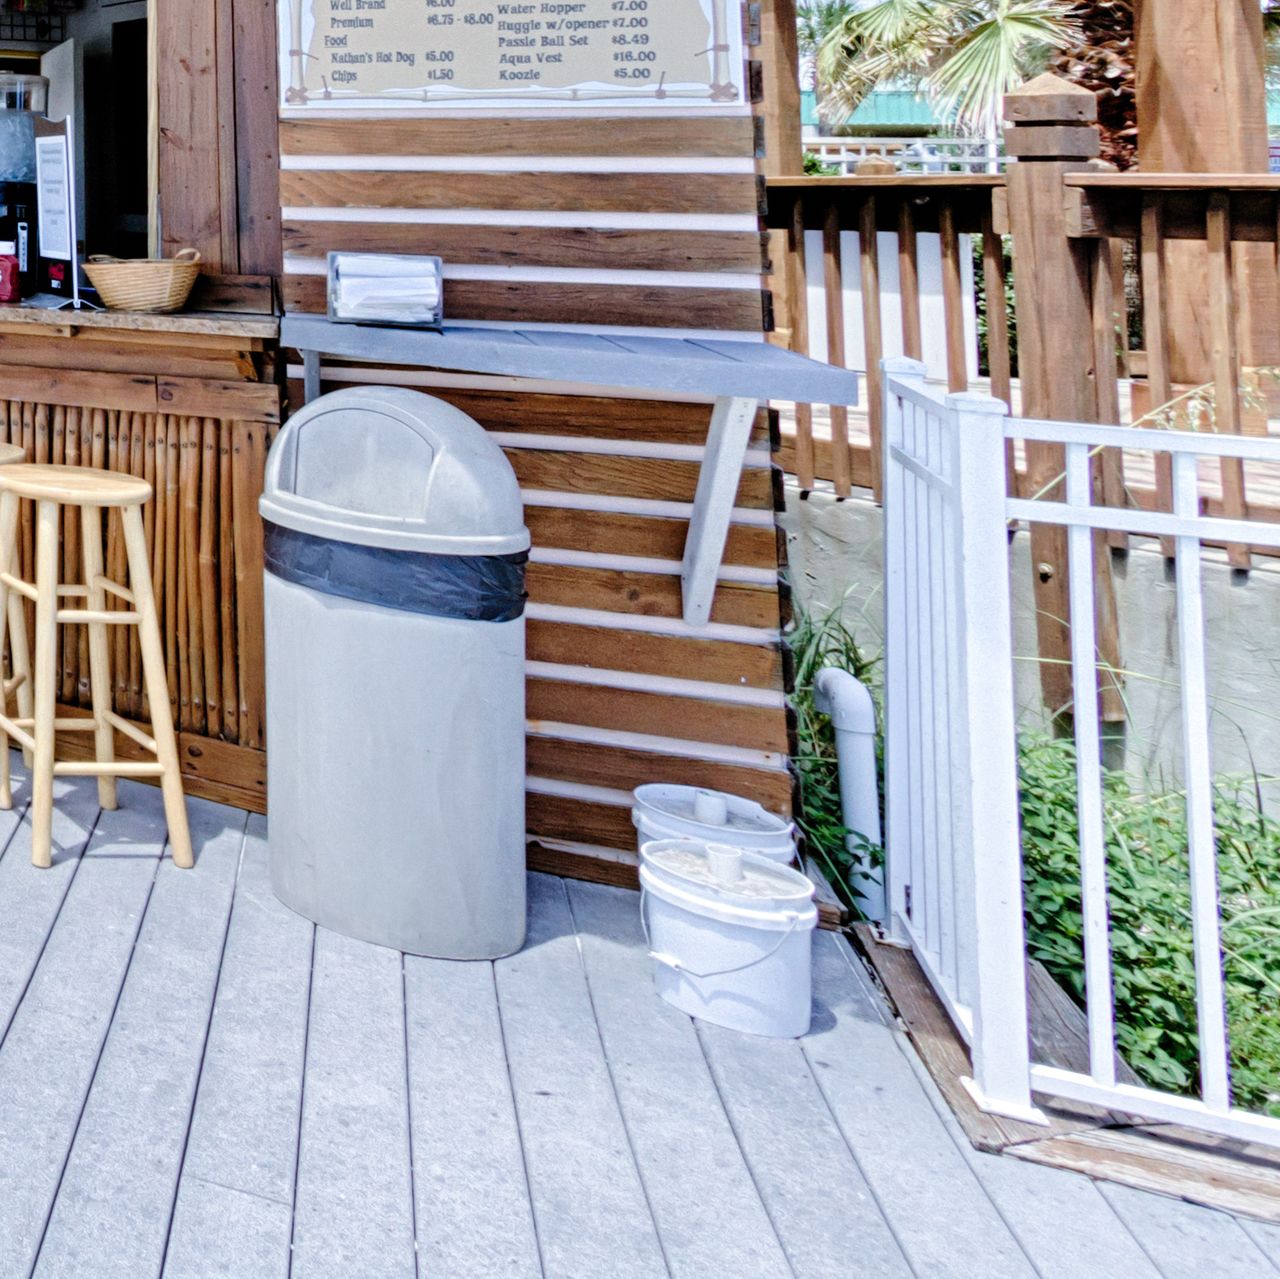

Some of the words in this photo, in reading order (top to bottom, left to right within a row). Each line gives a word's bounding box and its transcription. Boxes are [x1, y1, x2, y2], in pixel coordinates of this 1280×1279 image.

[330, 0, 352, 10] Well
[497, 4, 536, 15] Water
[540, 2, 586, 15] Hopper
[611, 0, 648, 11] $7.00
[330, 17, 374, 29] Premium
[427, 14, 454, 25] $6.75
[463, 13, 494, 25] $8.00
[497, 19, 541, 34] Huggie
[612, 17, 648, 28] $7.00
[324, 35, 348, 46] Food
[540, 35, 565, 46] Ball
[569, 35, 589, 45] Set
[611, 34, 649, 45] $8.49
[331, 52, 373, 64] Nathan's
[376, 52, 392, 63] Hot
[396, 51, 415, 66] Dog
[426, 51, 454, 62] $5.00
[499, 53, 531, 66] Aqua
[536, 52, 563, 63] Vest
[613, 51, 656, 62] $16.00
[331, 70, 357, 84] Chips
[428, 69, 454, 80] $1.50
[499, 69, 541, 80] Koozie
[614, 68, 651, 79] $5.00
